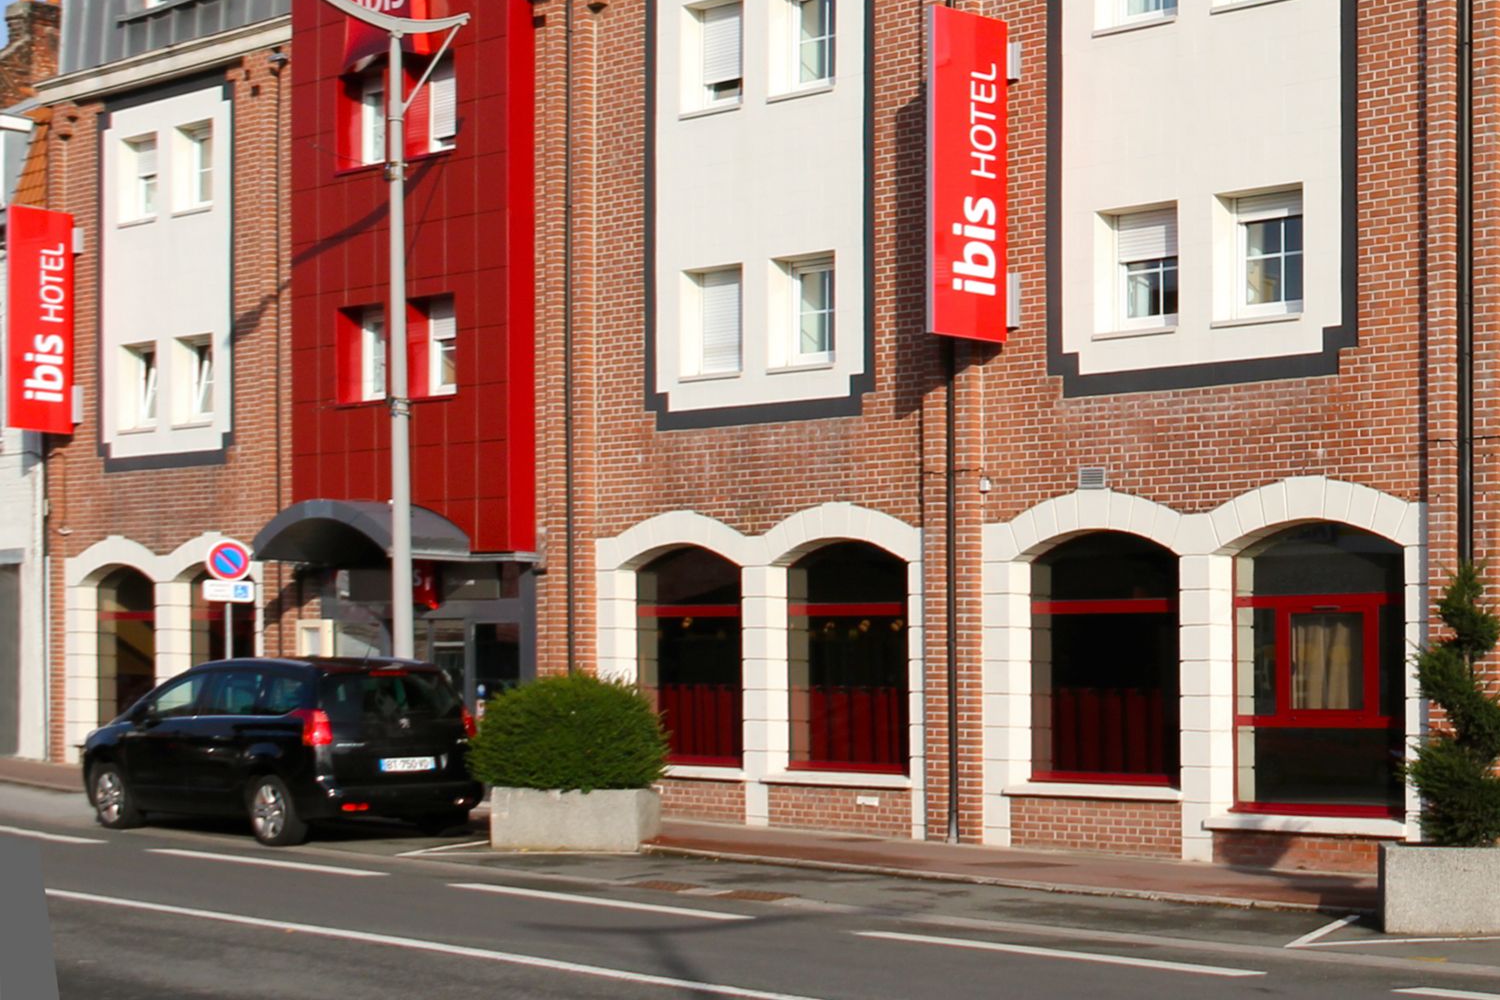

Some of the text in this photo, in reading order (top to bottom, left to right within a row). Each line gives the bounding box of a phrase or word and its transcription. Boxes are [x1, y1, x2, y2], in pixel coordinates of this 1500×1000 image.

[952, 63, 996, 296] ibis HOTEL
[24, 243, 64, 402] ibis HOTEL
